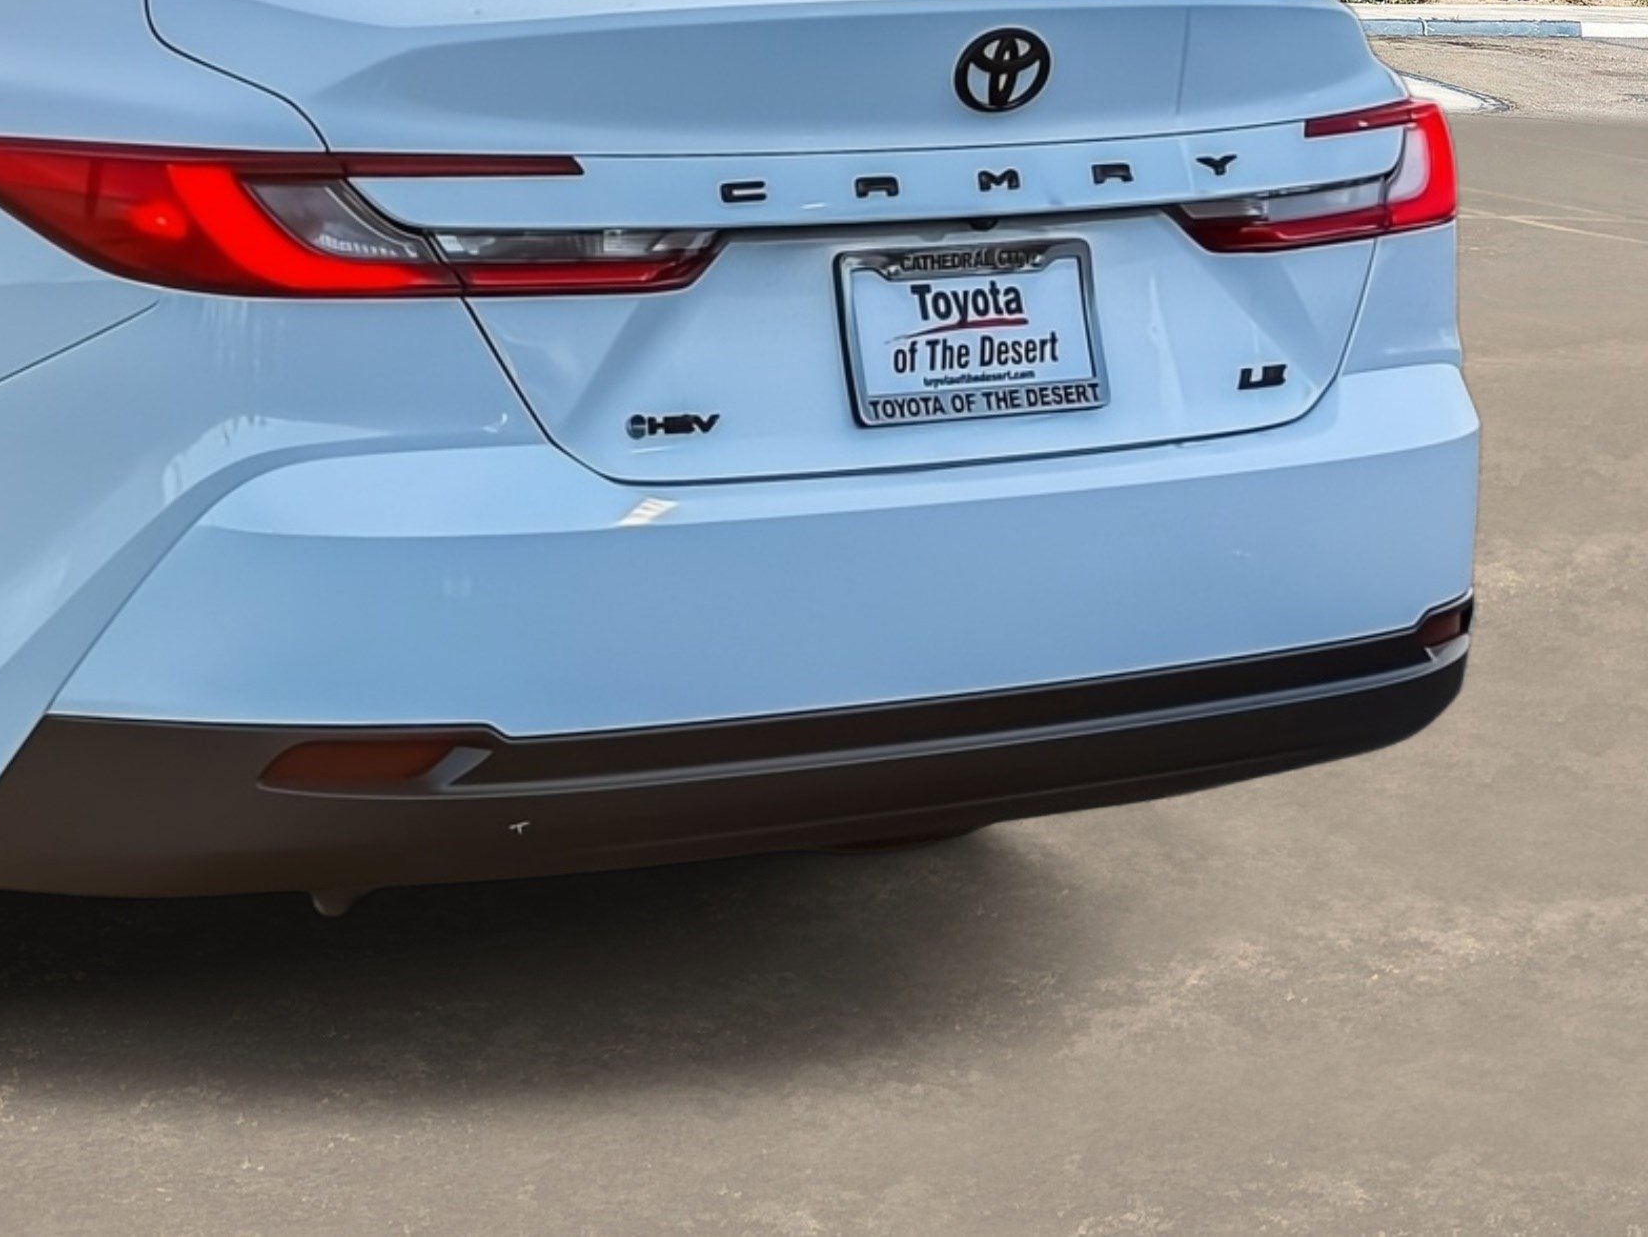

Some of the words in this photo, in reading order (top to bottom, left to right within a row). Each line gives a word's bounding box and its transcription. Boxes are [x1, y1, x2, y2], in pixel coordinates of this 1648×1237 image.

[720, 153, 1237, 203] CAMRY
[902, 249, 992, 270] CATHEDRAL
[910, 280, 1024, 326] Toyota
[893, 338, 918, 373] of
[926, 337, 970, 371] The
[979, 331, 1058, 367] Desert
[869, 396, 945, 419] TOYOTA
[952, 393, 977, 412] OF
[982, 389, 1021, 410] THE
[1026, 382, 1100, 407] DESERT
